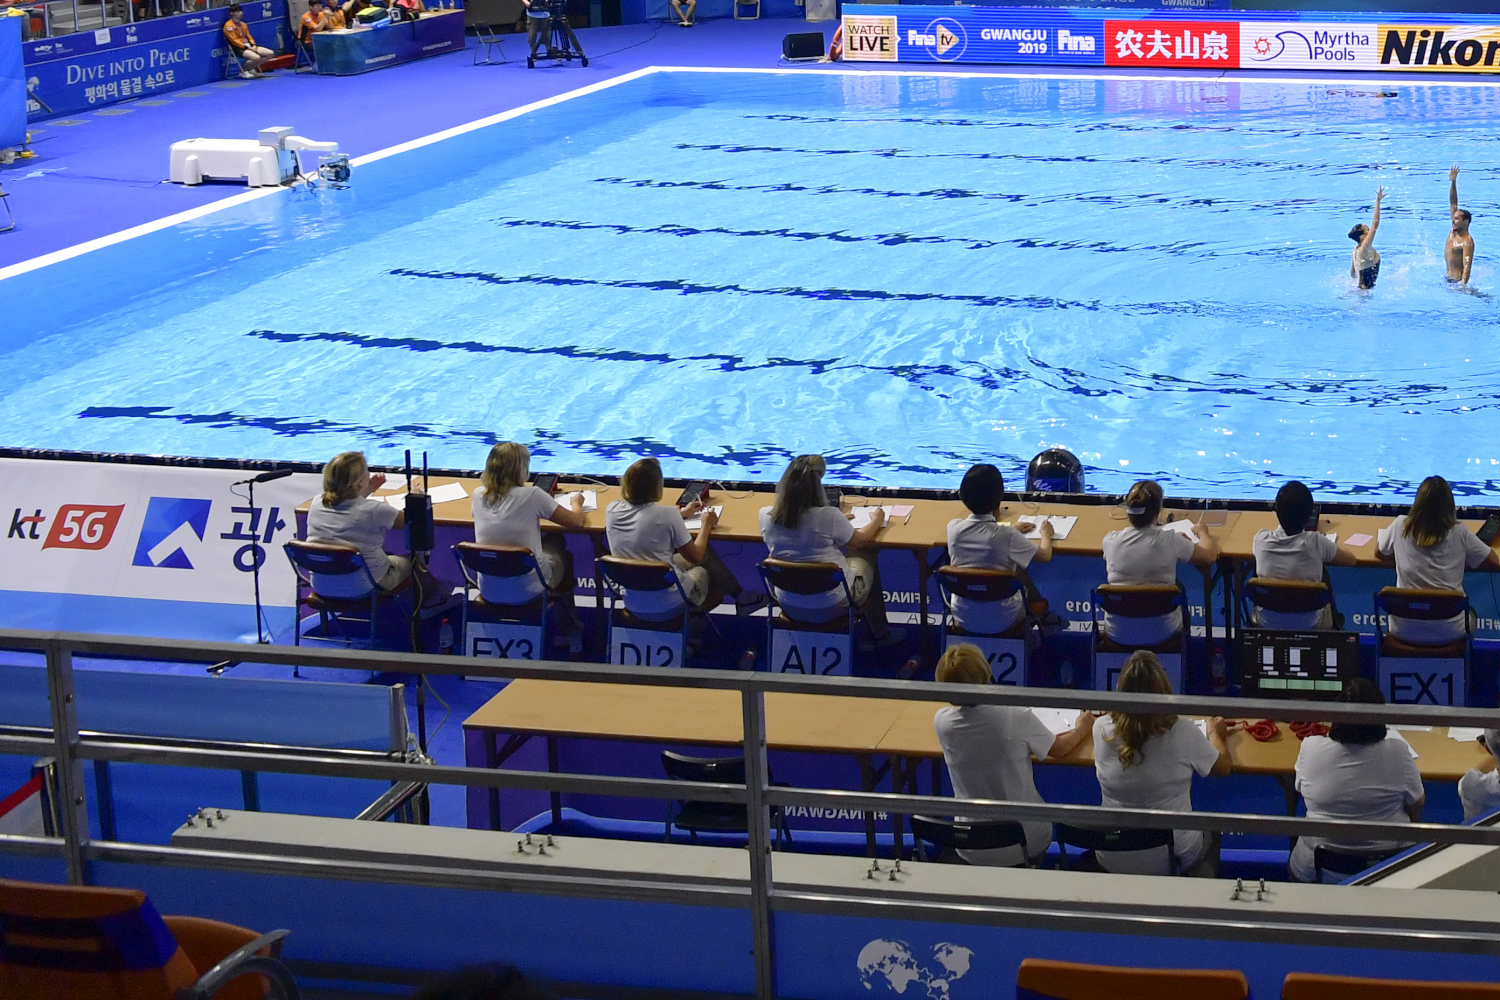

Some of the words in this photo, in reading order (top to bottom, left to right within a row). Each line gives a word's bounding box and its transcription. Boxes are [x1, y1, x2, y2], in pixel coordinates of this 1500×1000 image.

[848, 25, 890, 35] WATCH
[981, 28, 1047, 41] GWANGJU
[849, 36, 890, 52] LIVE
[941, 33, 953, 46] tv
[1114, 28, 1230, 61] 农夫山泉
[1313, 31, 1369, 48] Myrtha
[1018, 42, 1048, 54] 2019
[1313, 47, 1356, 61] Pools
[66, 63, 105, 85] DIVE
[109, 57, 145, 77] INTO
[149, 48, 191, 69] PEACE
[84, 82, 118, 104] 평화의
[120, 77, 142, 96] 물결
[144, 69, 175, 90] 속으로
[7, 508, 46, 540] kt
[58, 509, 107, 544] 5G
[1389, 672, 1454, 706] EX1
